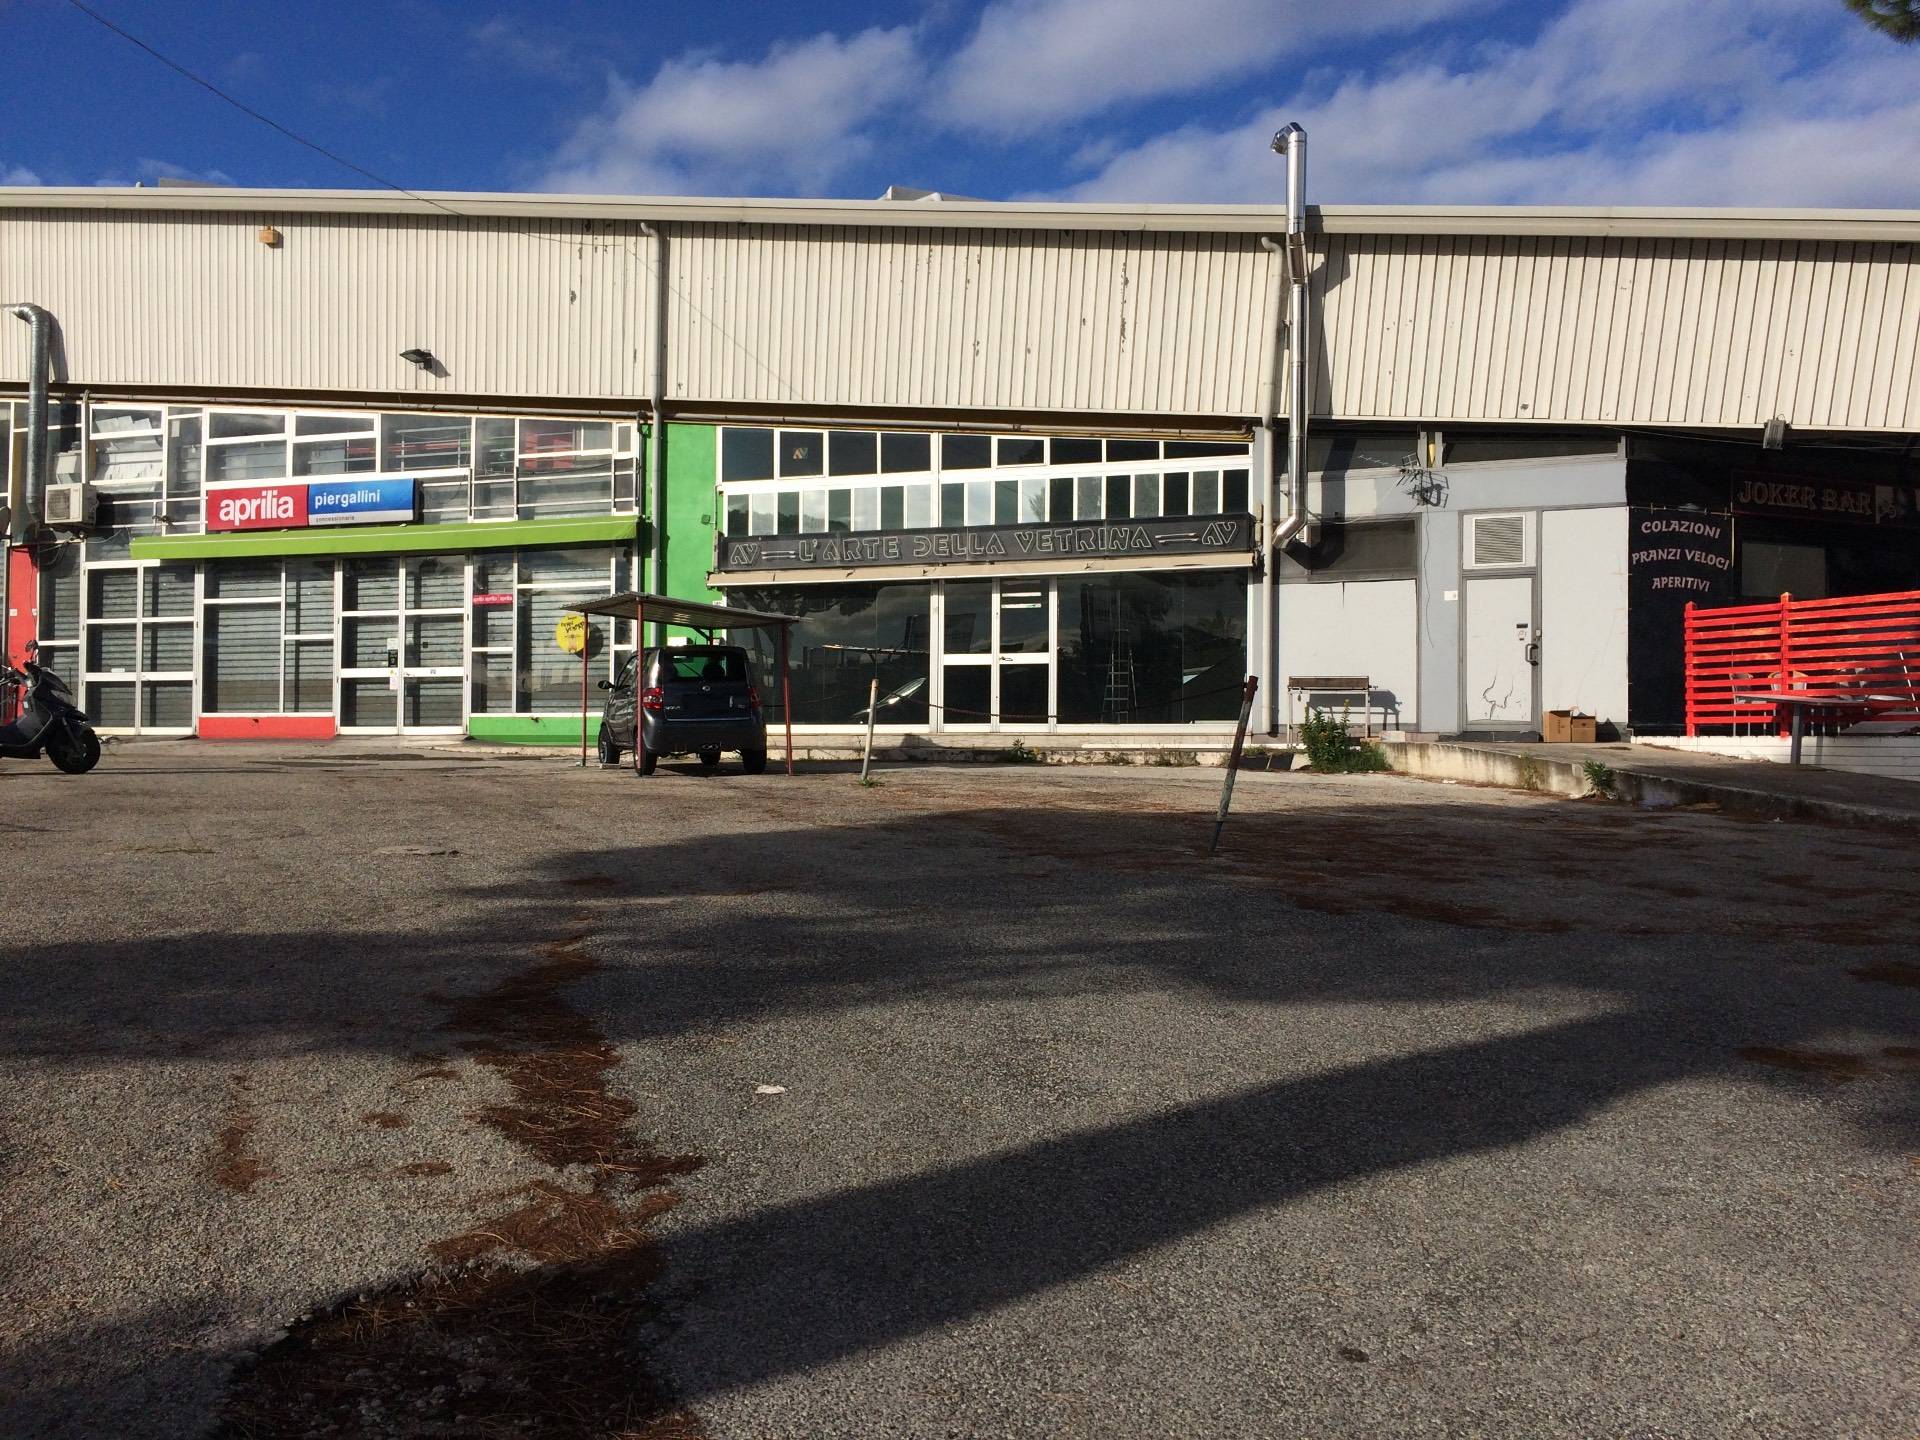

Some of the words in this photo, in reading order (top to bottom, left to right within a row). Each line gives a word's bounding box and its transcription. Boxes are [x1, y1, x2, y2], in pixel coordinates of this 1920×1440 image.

[219, 489, 294, 526] aprilia
[314, 489, 381, 509] piergallini
[1737, 480, 1817, 511] JOKER
[1823, 488, 1873, 516] BAR
[1641, 520, 1721, 539] COLAZIONI
[913, 532, 1005, 558] DELLA
[1014, 525, 1152, 553] VETRINA
[1632, 548, 1681, 565] PRANZI
[1684, 549, 1730, 571] VELOCI
[1651, 576, 1711, 593] APERITIVI
